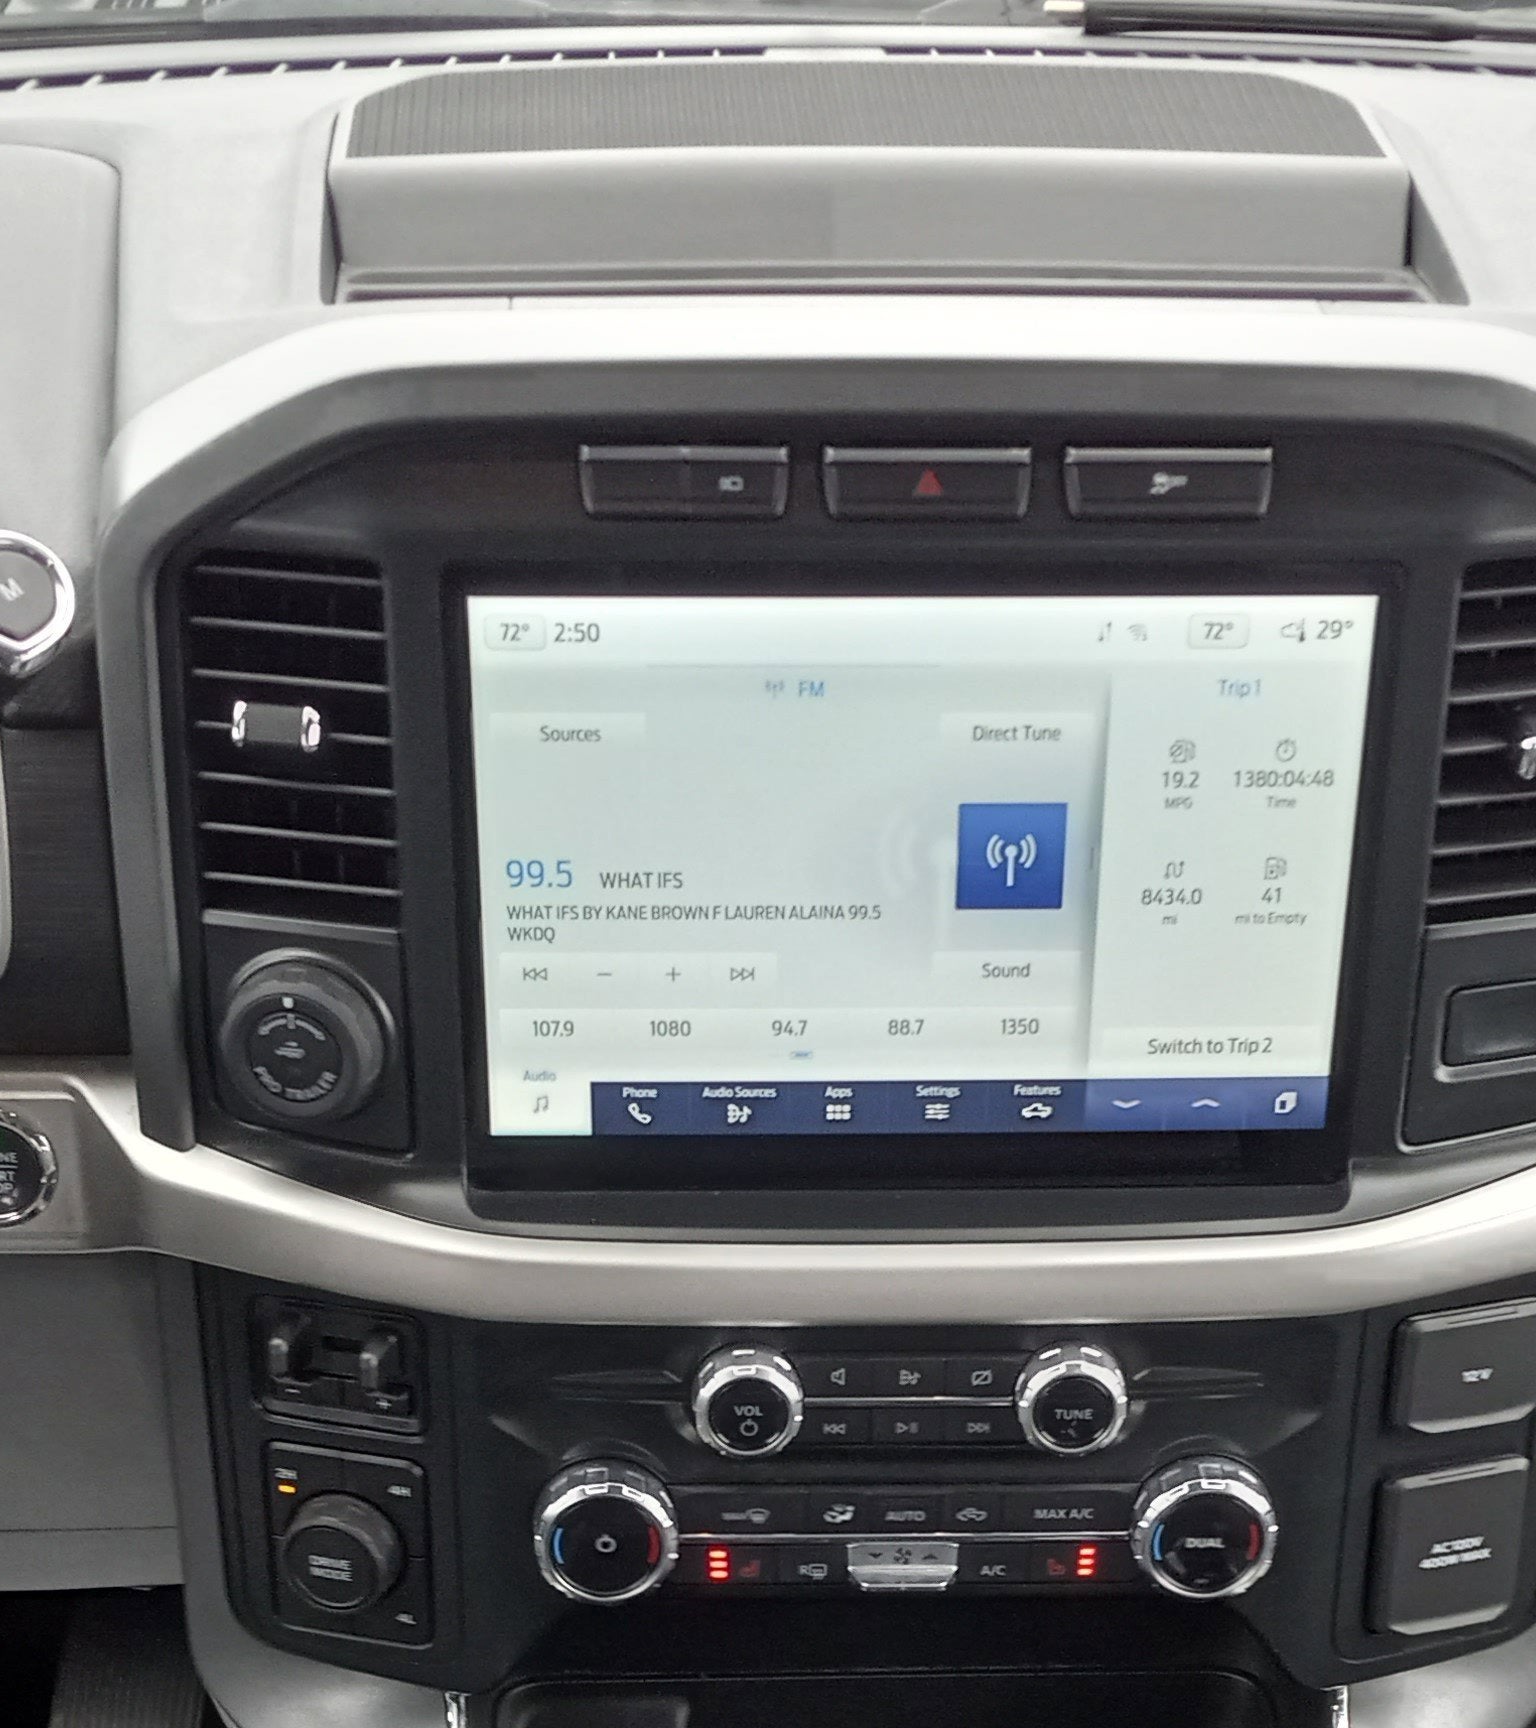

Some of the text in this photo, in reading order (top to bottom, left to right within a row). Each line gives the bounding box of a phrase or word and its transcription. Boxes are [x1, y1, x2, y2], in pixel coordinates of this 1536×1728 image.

[499, 621, 601, 643] 72° 2:50
[1202, 621, 1235, 642] 72°
[1315, 619, 1355, 641] 29°
[797, 679, 826, 698] FM
[1217, 677, 1252, 699] Trip
[539, 723, 602, 743] Sources
[972, 723, 1062, 742] Direct Tune
[1161, 769, 1201, 789] 19.2
[1233, 769, 1335, 789] 1380:04:48
[1164, 796, 1194, 811] MPG
[1265, 795, 1298, 810] Time
[505, 859, 684, 890] 99.5 WHAT IFS
[1141, 887, 1204, 907] 8434.0
[1261, 886, 1283, 906] 41
[506, 904, 882, 921] WHAT IFS BY KANE BROWN F LAUREN ALAINA 99.5
[1161, 912, 1179, 926] mi
[1234, 910, 1308, 928] mi to Empty
[507, 926, 556, 944] WKDQ
[980, 961, 1032, 979] Sound
[531, 1019, 575, 1039] 107.9
[649, 1019, 693, 1039] 1080
[770, 1019, 808, 1038] 94.7
[886, 1018, 925, 1037] 88.7
[999, 1017, 1041, 1036] 1350
[1147, 1037, 1274, 1058] Switch to Trip 2
[522, 1069, 558, 1083] Audio
[621, 1085, 659, 1099] Phone
[701, 1085, 778, 1099] Audio Sources
[823, 1085, 854, 1101] Apps
[914, 1084, 962, 1100] Settings
[1012, 1083, 1062, 1098] Features
[733, 1404, 764, 1418] VOL
[1053, 1407, 1094, 1421] TUNE
[885, 1510, 927, 1523] AUTO
[1033, 1507, 1095, 1521] MAX A/C
[1183, 1536, 1226, 1550] DUAL
[980, 1564, 1007, 1578] A/C
